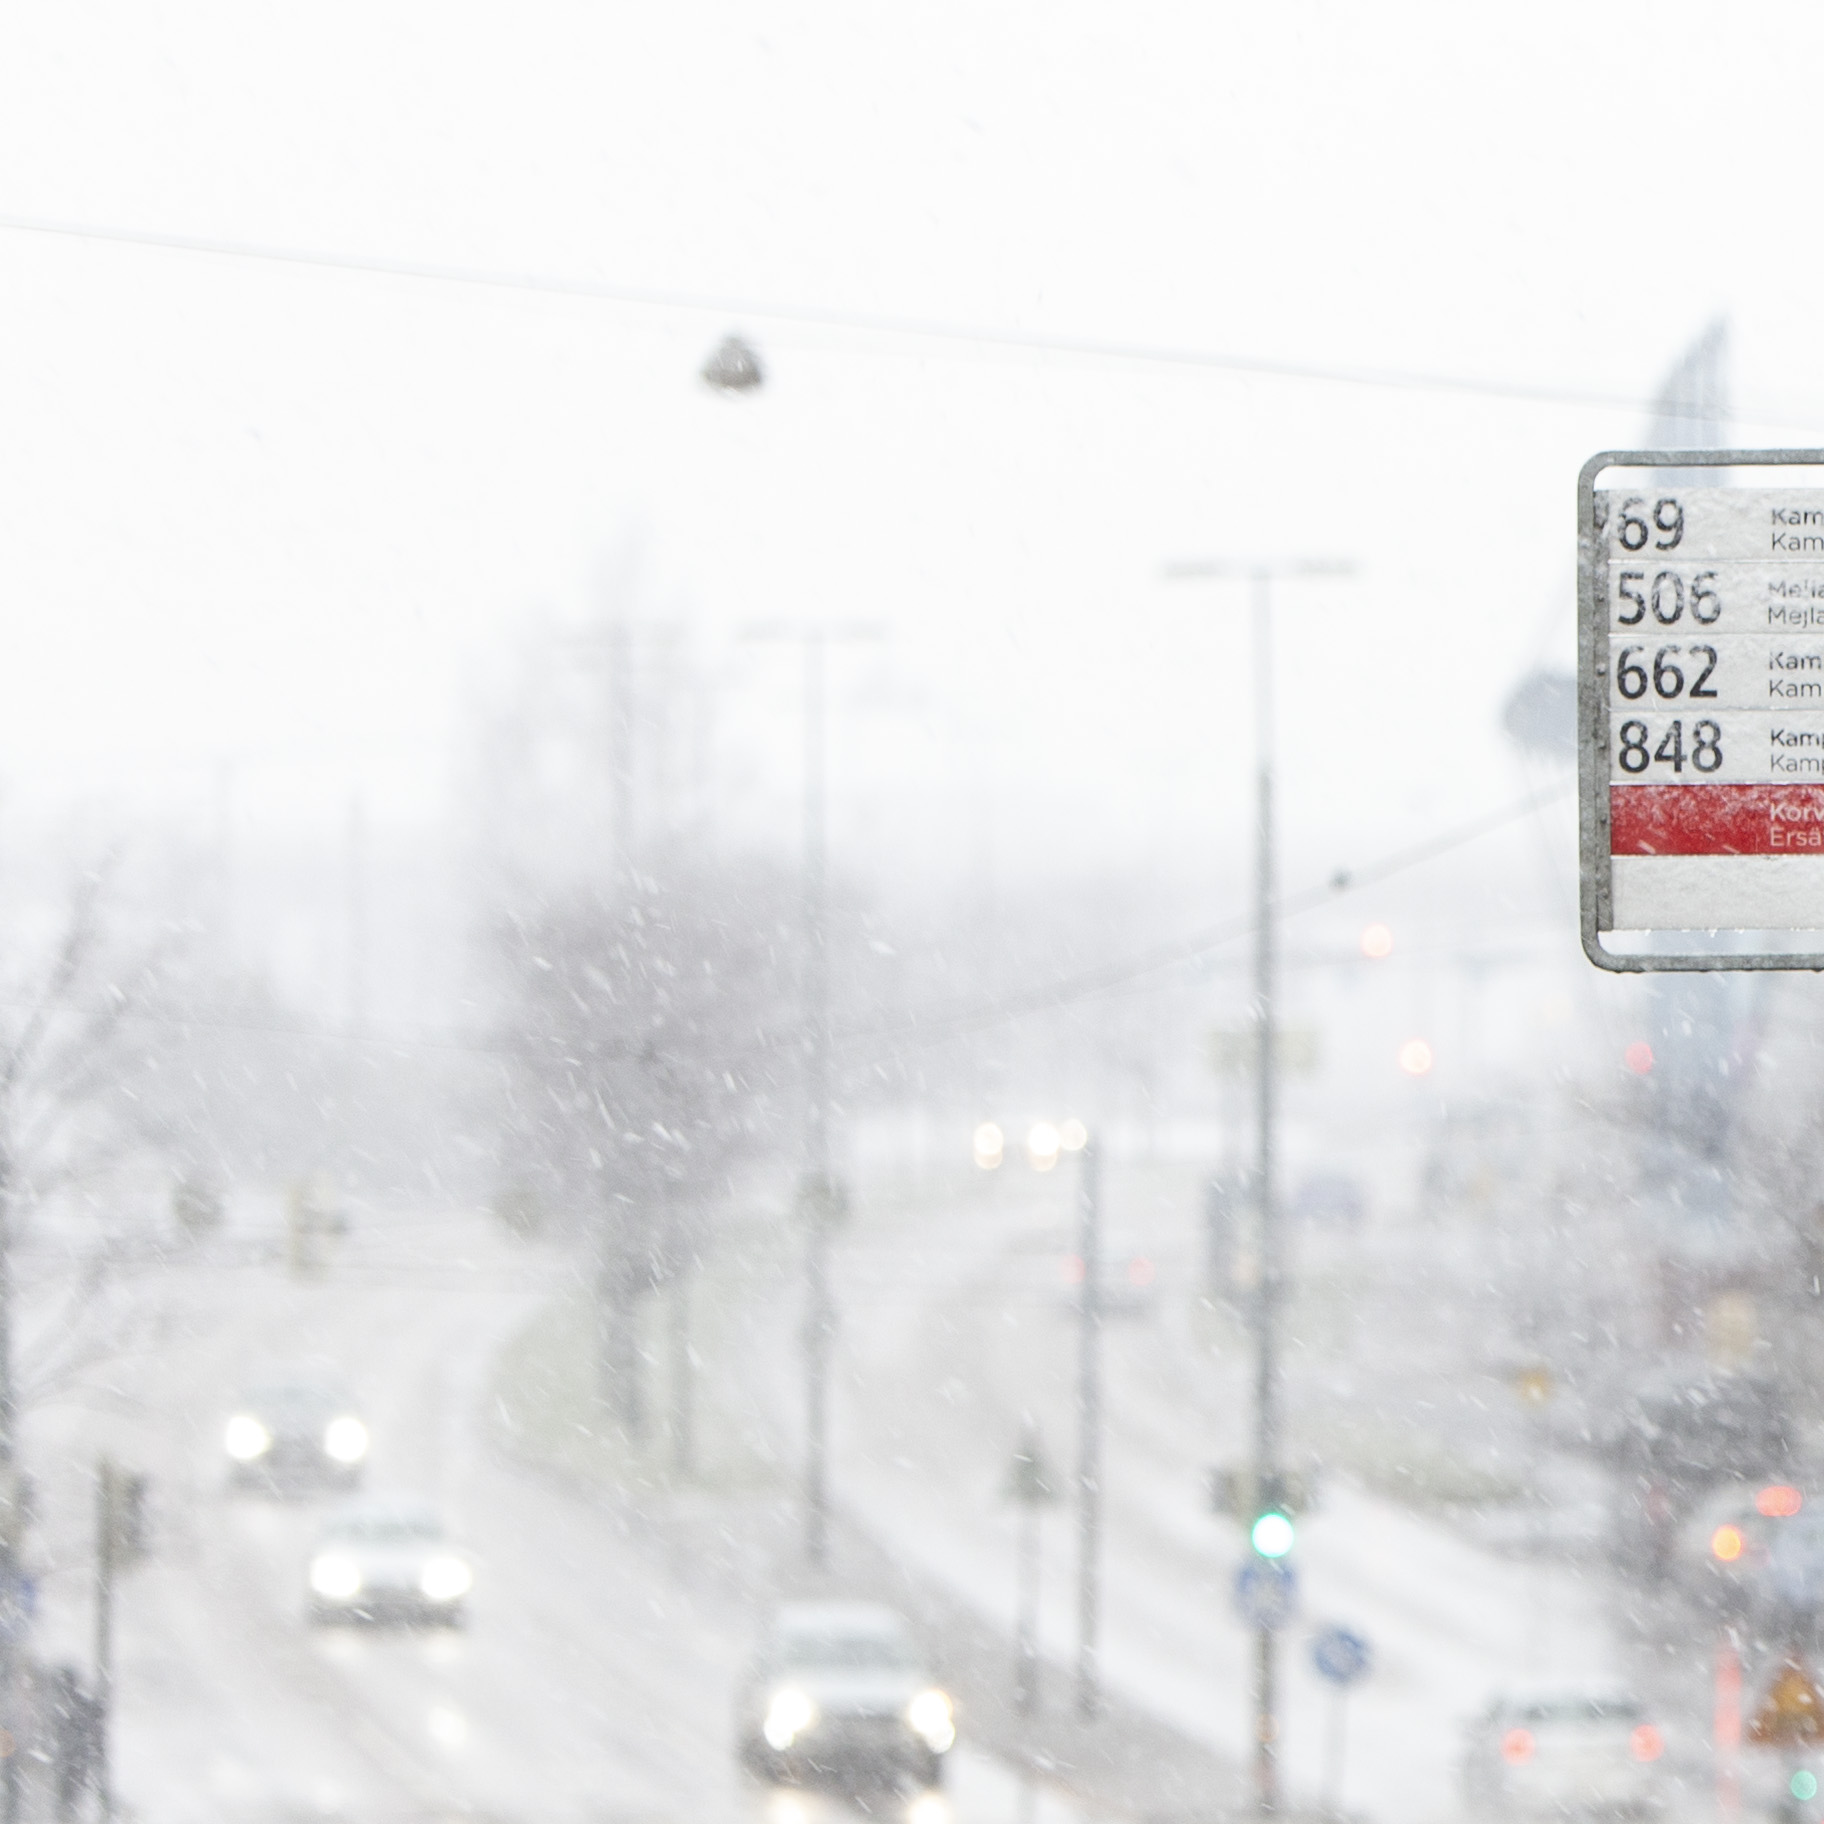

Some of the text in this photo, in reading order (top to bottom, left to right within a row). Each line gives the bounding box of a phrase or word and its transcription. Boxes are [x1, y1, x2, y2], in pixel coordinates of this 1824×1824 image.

[1617, 498, 1685, 551] 69
[1617, 570, 1722, 626] 506
[1616, 645, 1719, 700] 662
[1618, 720, 1724, 774] 848
